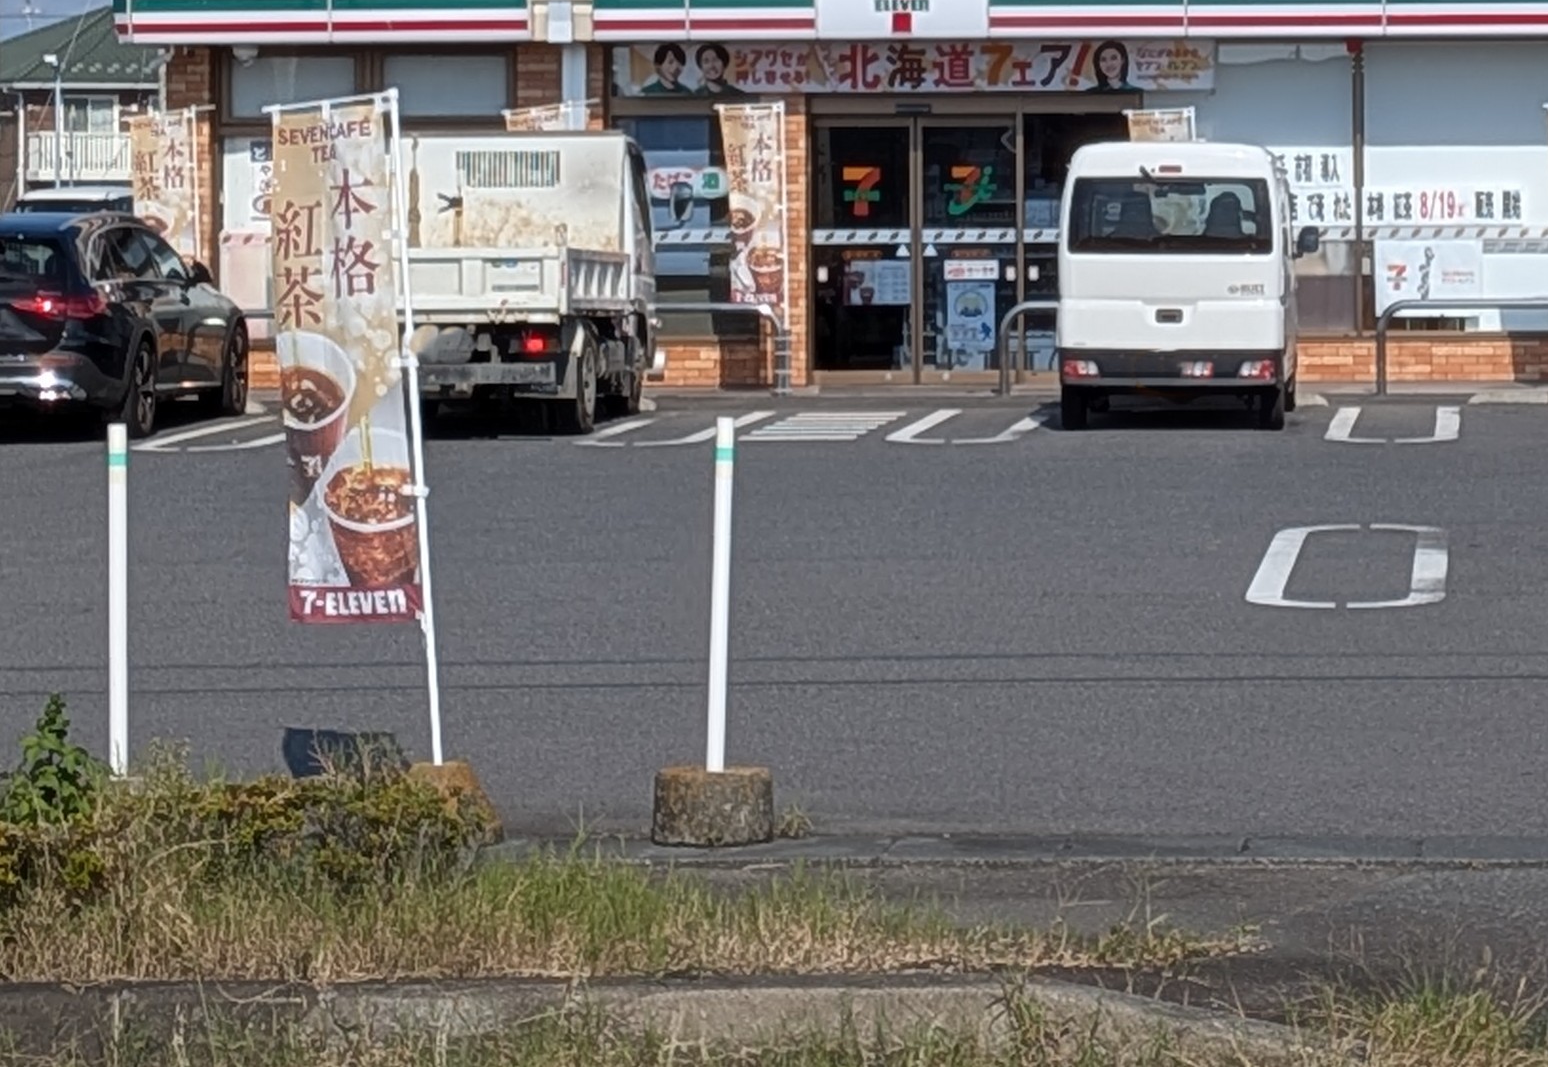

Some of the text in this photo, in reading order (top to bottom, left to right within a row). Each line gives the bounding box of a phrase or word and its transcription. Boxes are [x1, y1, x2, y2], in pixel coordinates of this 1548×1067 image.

[163, 138, 185, 189] 本格
[312, 147, 337, 164] TEA
[752, 132, 772, 183] 本格
[330, 168, 381, 299] 本格
[276, 199, 324, 329] 紅茶
